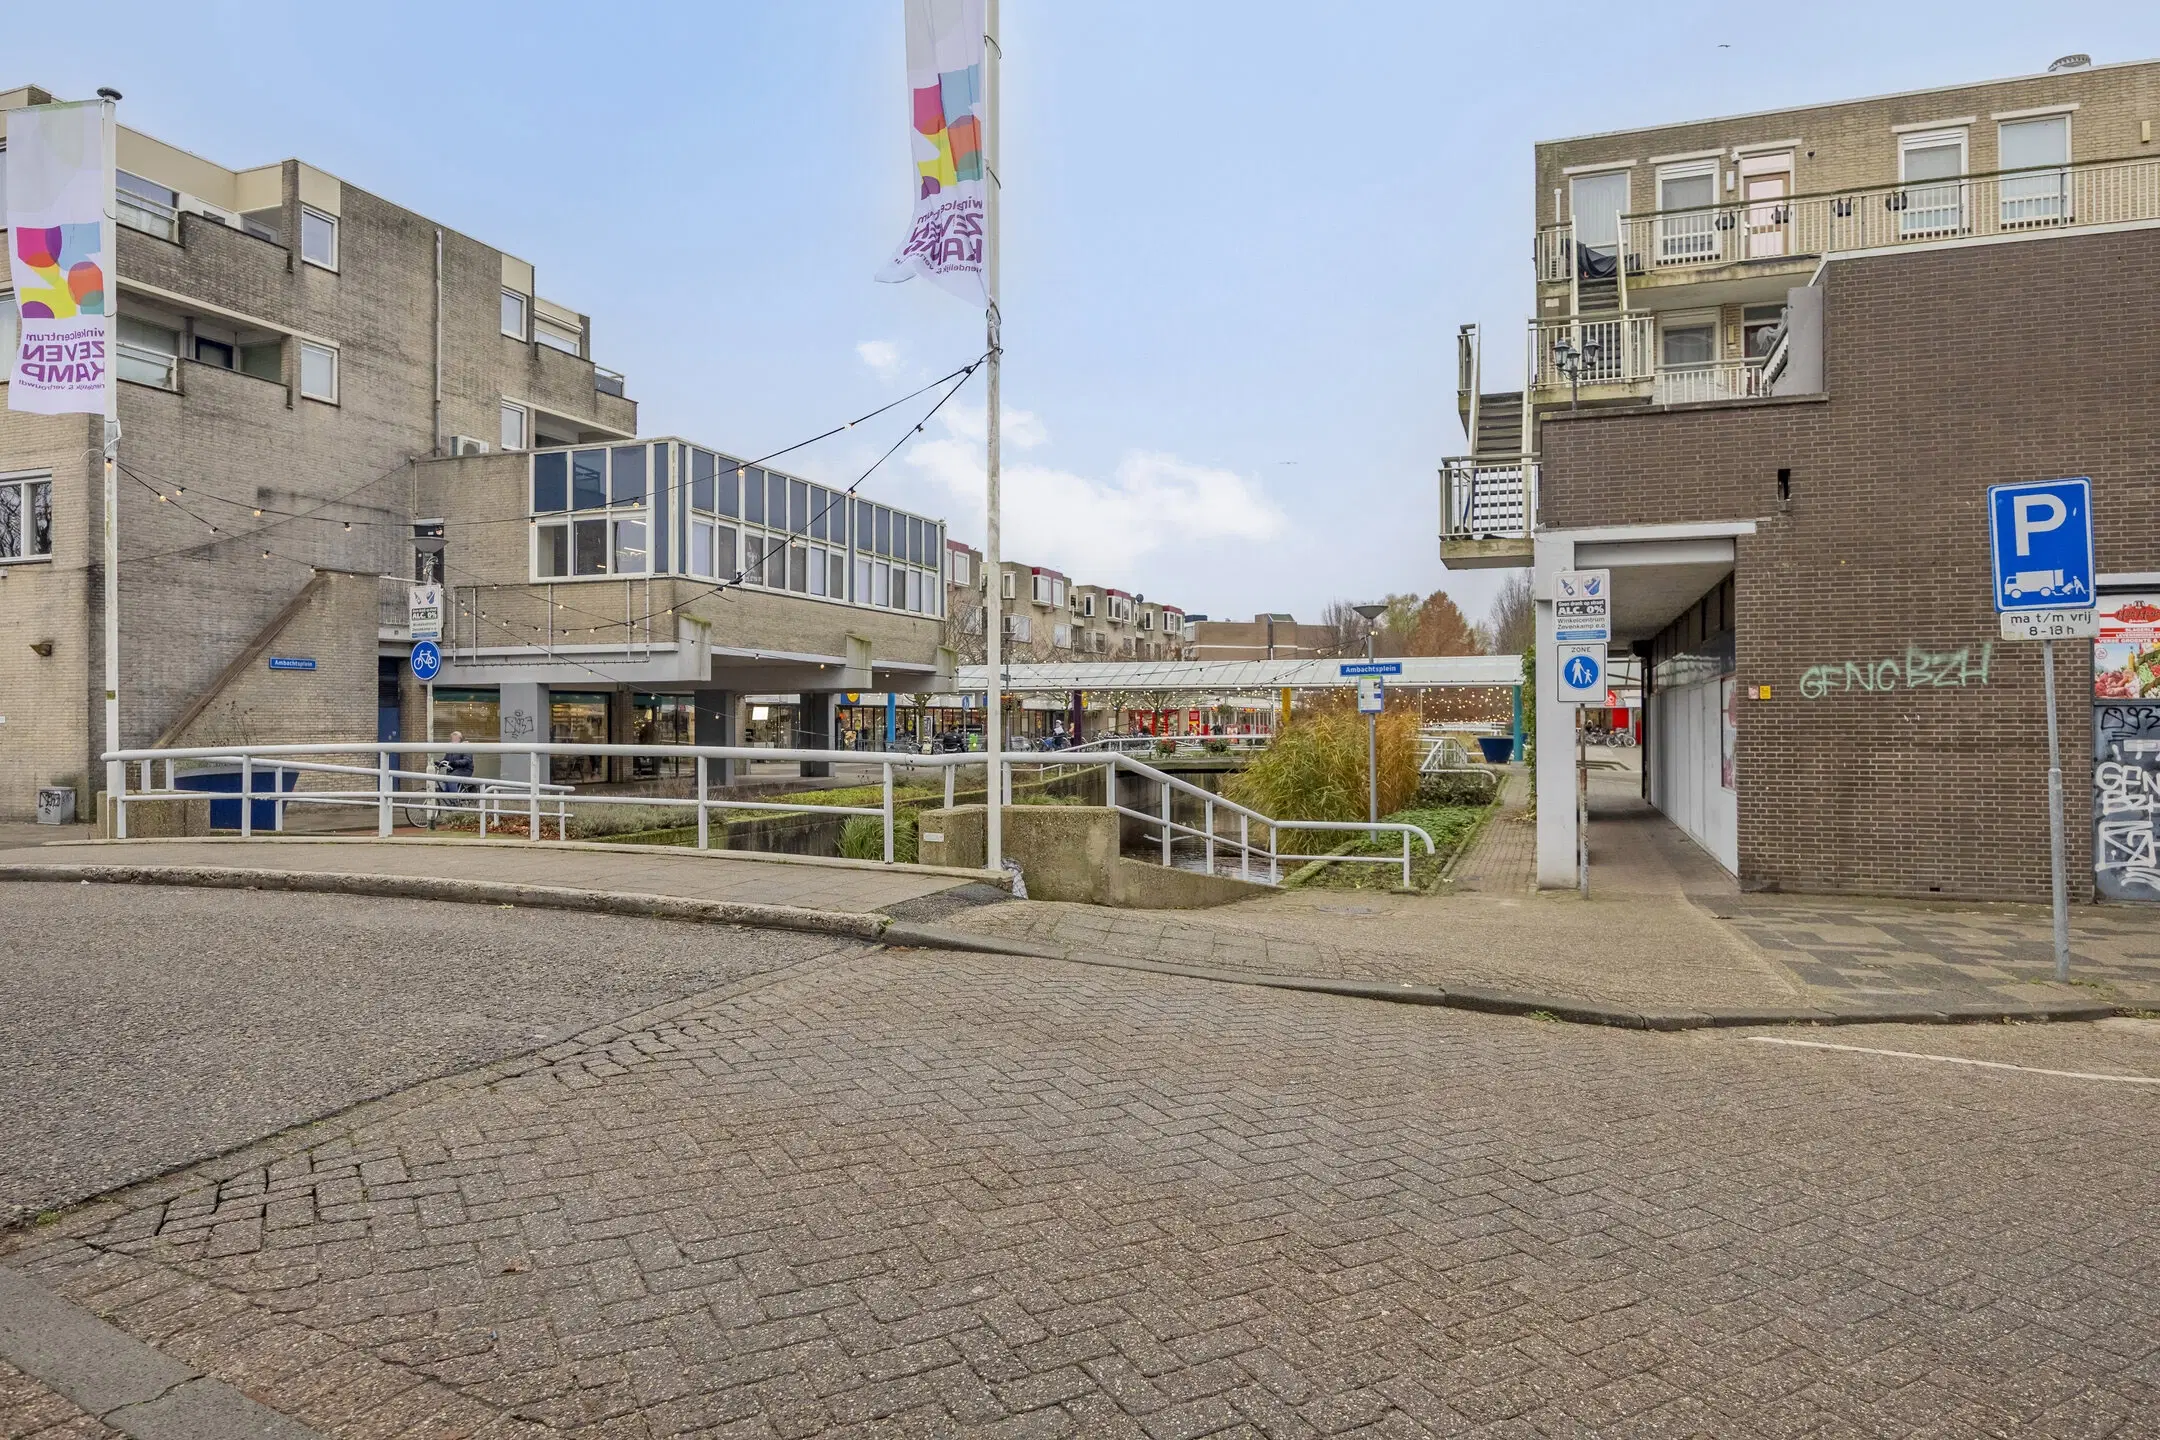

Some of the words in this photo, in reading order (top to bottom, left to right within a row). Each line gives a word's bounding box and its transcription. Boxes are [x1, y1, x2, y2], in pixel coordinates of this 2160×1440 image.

[2013, 493, 2067, 556] P
[1557, 606, 1583, 614] ALC.
[1586, 604, 1604, 614] 0%
[2011, 615, 2030, 624] ma
[2036, 612, 2064, 623] t/m
[2070, 610, 2092, 623] vrij
[275, 659, 313, 668] Ambachtsplein
[1345, 666, 1396, 674] Ambachtsplein
